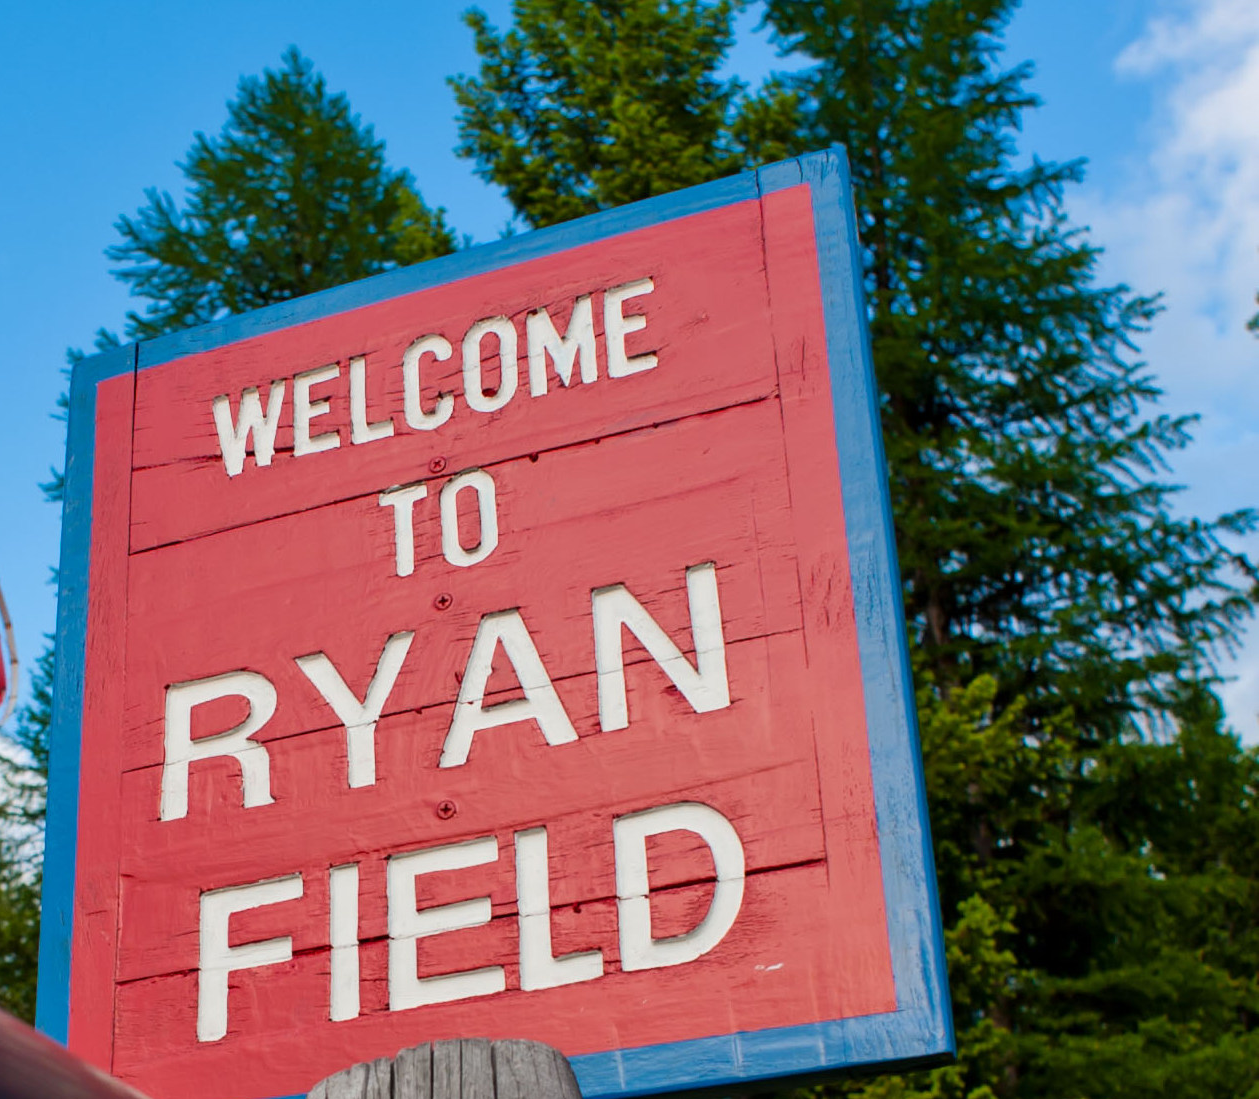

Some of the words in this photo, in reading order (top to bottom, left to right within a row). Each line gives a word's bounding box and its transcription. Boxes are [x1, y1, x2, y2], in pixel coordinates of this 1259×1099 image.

[213, 277, 659, 476] WELCOME
[379, 469, 500, 577] TO
[160, 562, 731, 821] RYAN
[197, 802, 745, 1042] FIELD
